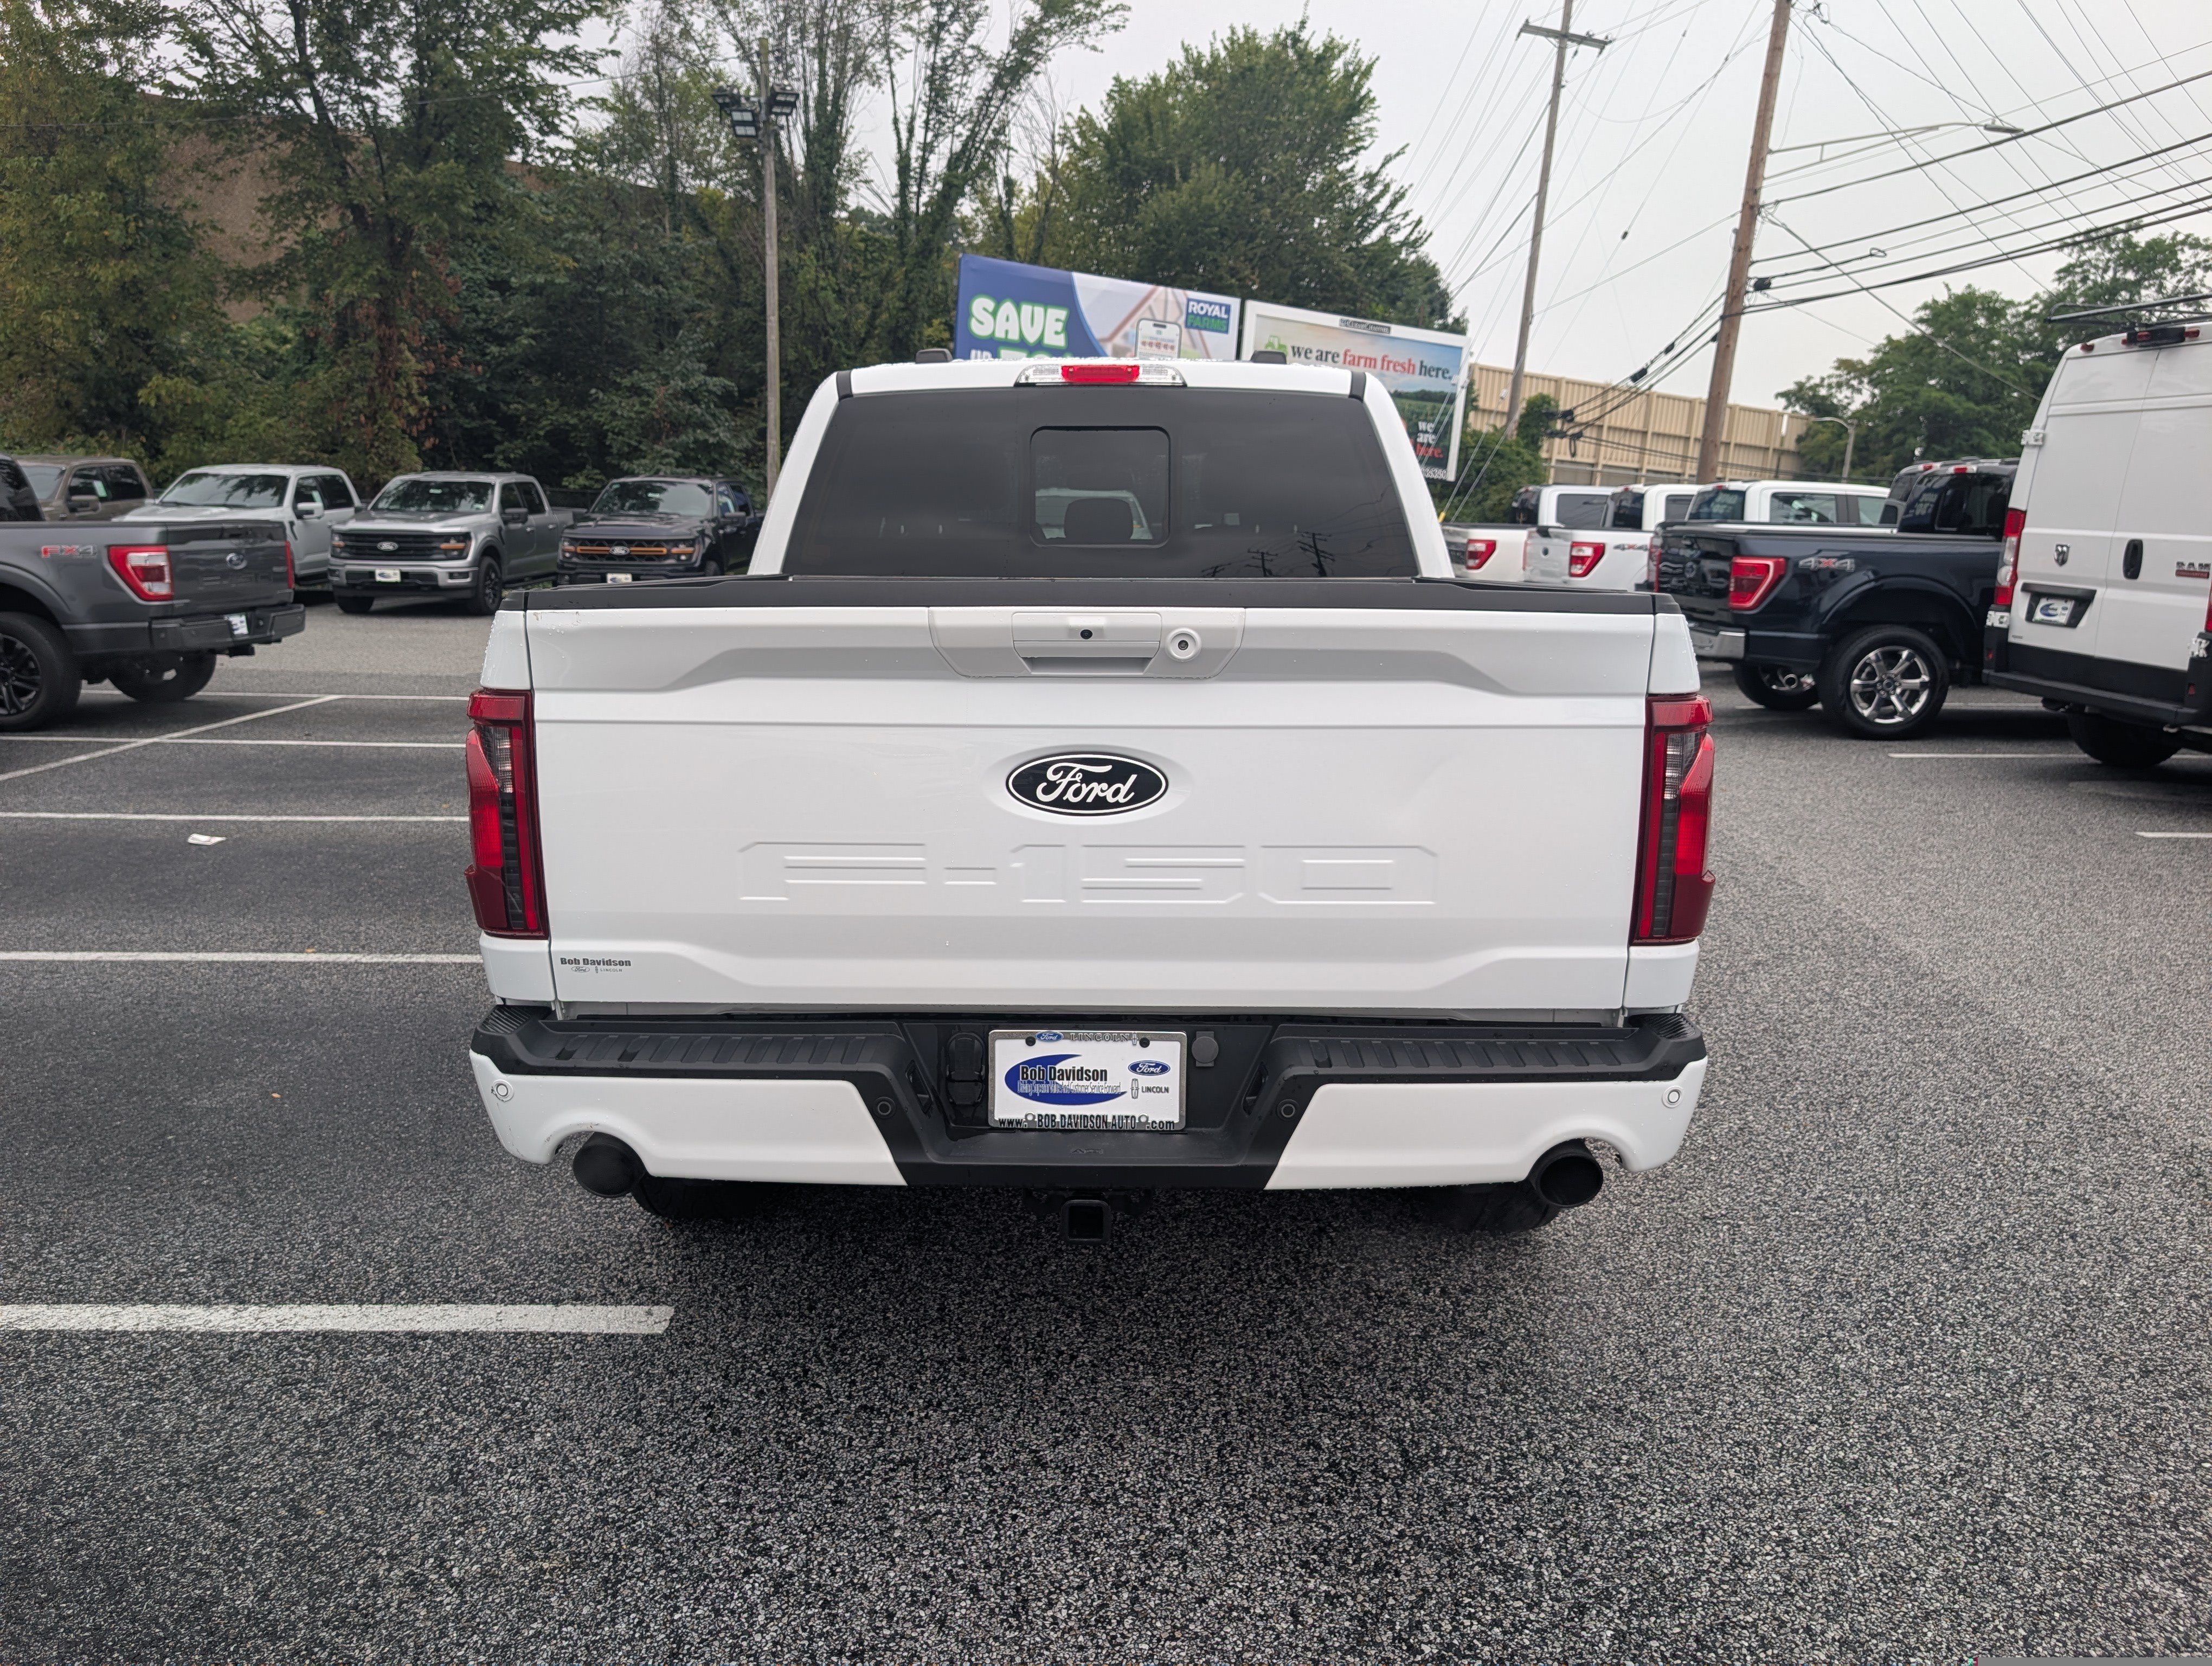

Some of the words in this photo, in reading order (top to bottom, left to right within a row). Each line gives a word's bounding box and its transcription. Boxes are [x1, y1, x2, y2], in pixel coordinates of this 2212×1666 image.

[1188, 301, 1229, 319] ROYAL
[970, 296, 1068, 347] SAVE
[1290, 344, 1313, 360] we
[1315, 348, 1340, 364] are
[1342, 349, 1377, 370] farm
[1380, 354, 1416, 375] fresh
[1419, 360, 1453, 380] here.
[1418, 421, 1435, 433] we
[1417, 432, 1436, 445] are
[41, 545, 97, 559] FX4
[1036, 761, 1135, 805] Ford
[738, 841, 1439, 905] F-150
[560, 957, 581, 965] Bob
[583, 958, 632, 966] Davidson
[1070, 1033, 1130, 1042] LINCOLN
[1020, 1065, 1046, 1081] Bob
[1049, 1066, 1108, 1082] Davidson
[1136, 1062, 1162, 1074] Ford
[1141, 1085, 1169, 1093] LINCOLN
[998, 1118, 1028, 1128] www.
[1037, 1114, 1056, 1128] BOB
[1059, 1114, 1108, 1129] DAVIDSON
[1111, 1114, 1136, 1129] AUTO
[1146, 1119, 1175, 1130] .com
